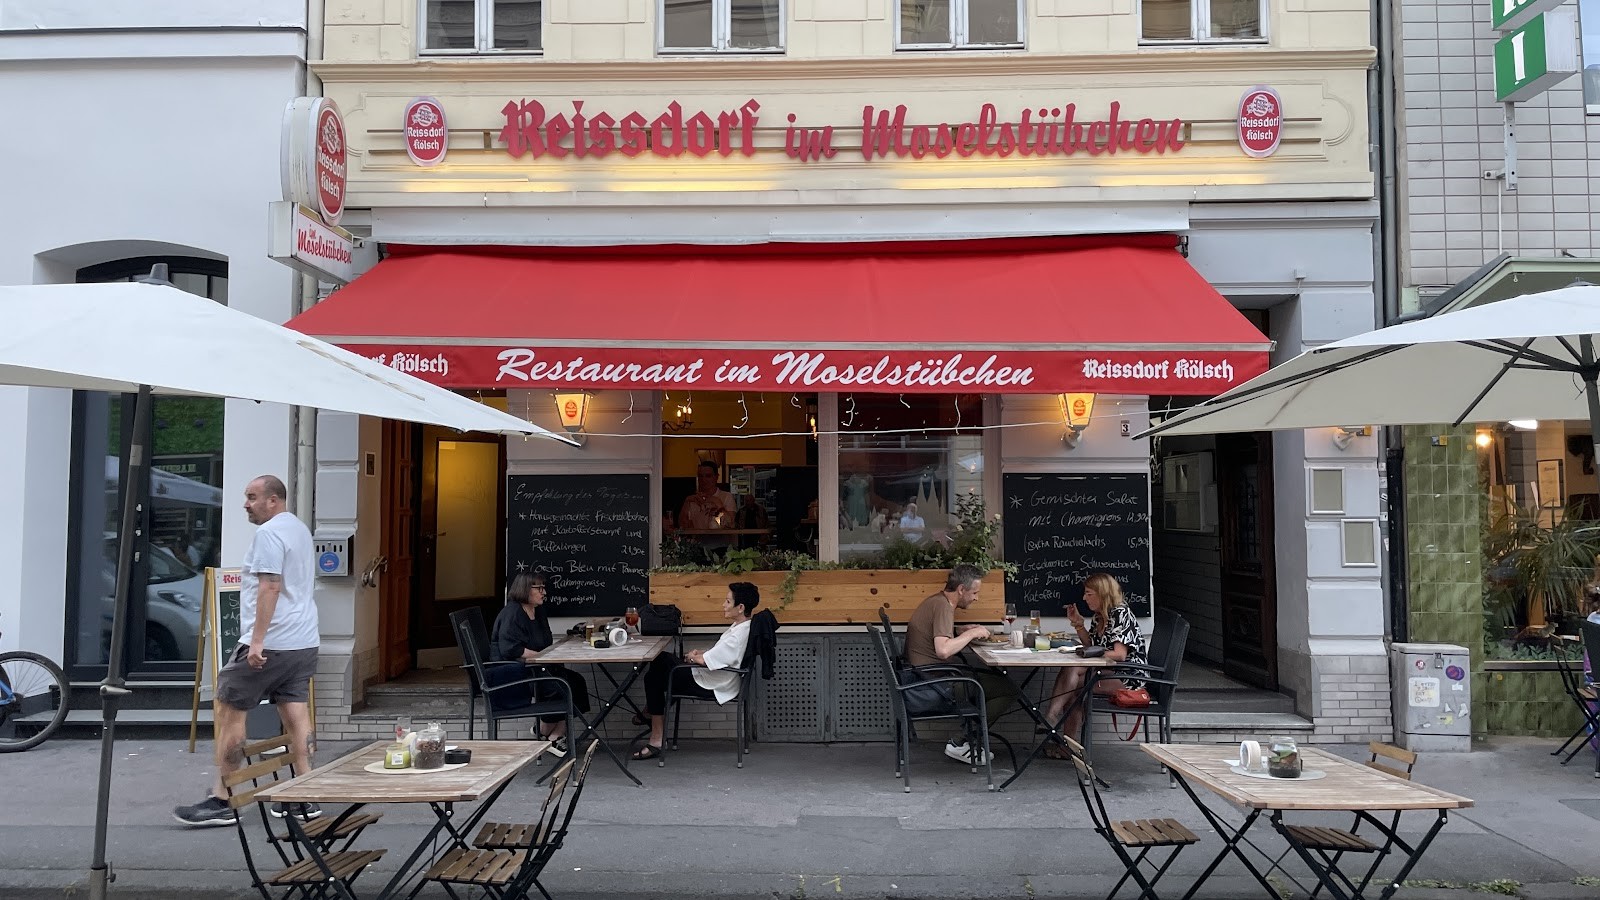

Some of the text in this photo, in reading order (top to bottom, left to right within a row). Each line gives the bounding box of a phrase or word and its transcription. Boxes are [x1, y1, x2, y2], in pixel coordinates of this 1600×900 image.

[1241, 116, 1279, 127] Reissdorf
[408, 127, 444, 137] Reissdorf
[499, 97, 1187, 162] Reissdorf im Moselstübchen
[1246, 129, 1273, 140] Kölsch
[413, 139, 440, 150] Kölsch
[297, 228, 352, 264] Moselstübchen
[390, 352, 448, 376] Kölsch
[495, 348, 1035, 386] Restaurant im Moselstübchen
[1082, 358, 1235, 383] Reissdorf Kölsch
[1122, 424, 1129, 433] 3
[1030, 491, 1138, 506] Gemischter Salat
[1029, 511, 1051, 527] mit
[531, 525, 549, 537] mit
[626, 530, 643, 539] und
[530, 560, 564, 573] Cordon
[565, 560, 594, 573] Bleu
[597, 563, 617, 573] mit
[1023, 575, 1040, 588] mit
